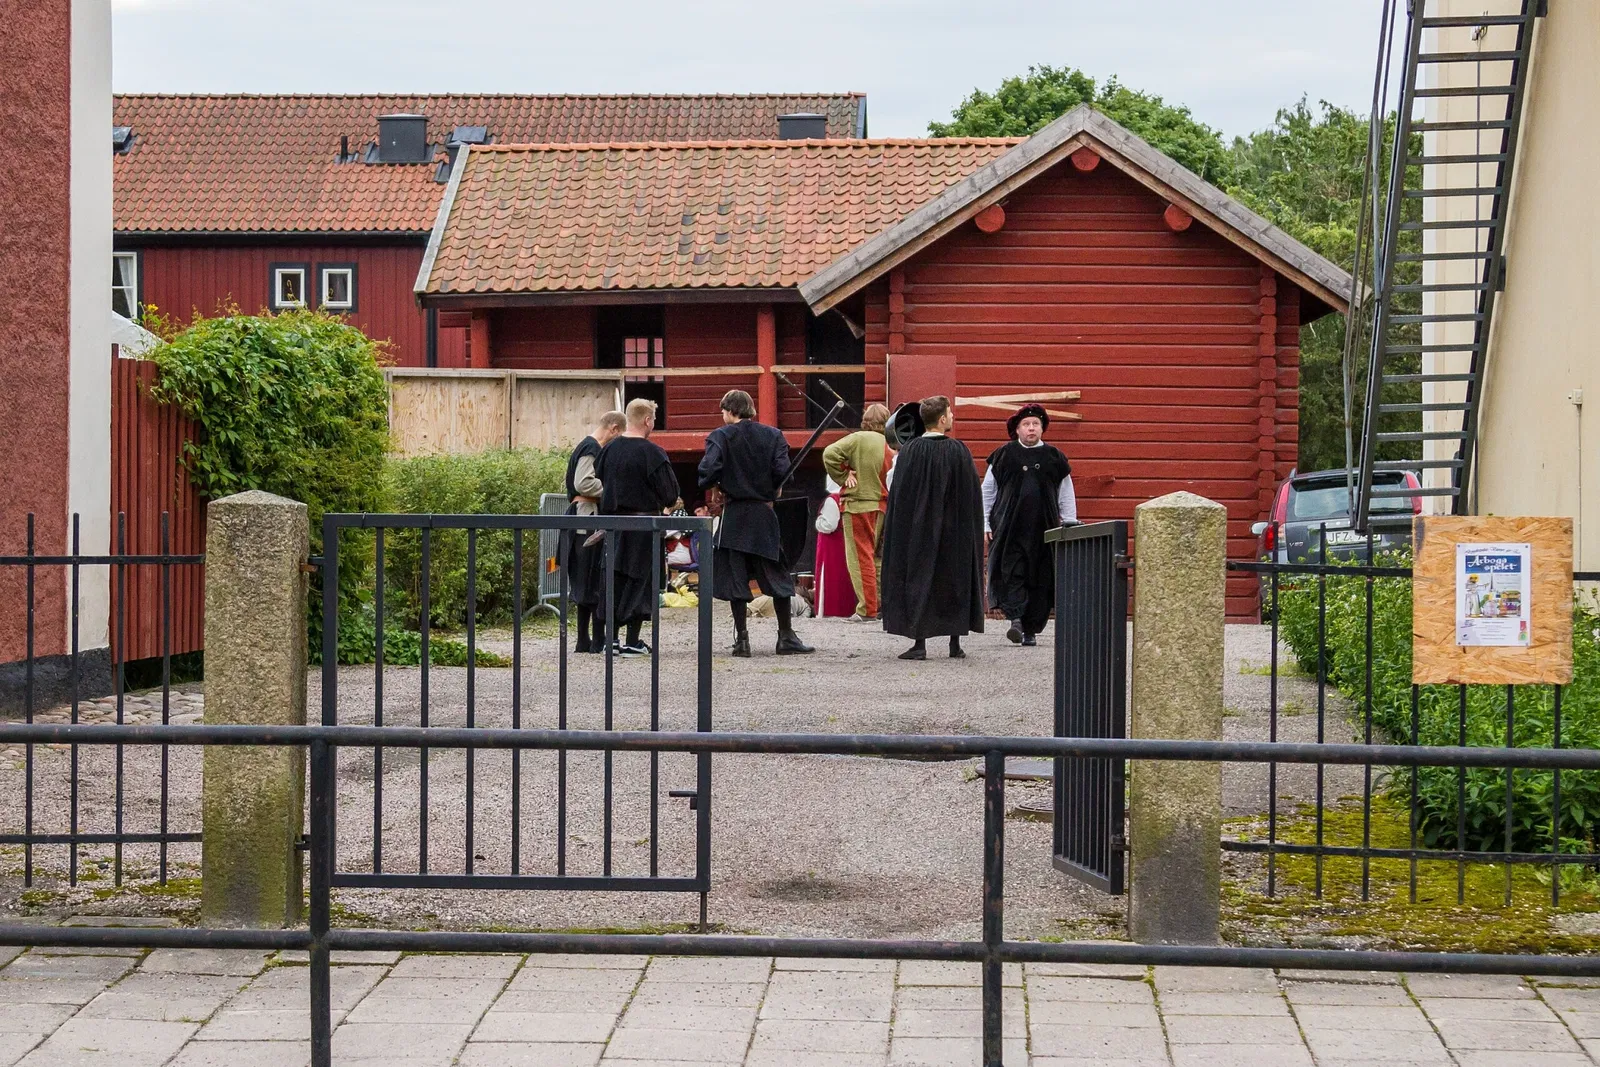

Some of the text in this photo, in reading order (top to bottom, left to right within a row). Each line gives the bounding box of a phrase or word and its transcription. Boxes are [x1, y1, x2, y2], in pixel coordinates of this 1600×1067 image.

[1328, 531, 1349, 542] JFZ
[1467, 555, 1508, 567] Arboga
[1484, 563, 1517, 572] spelet
